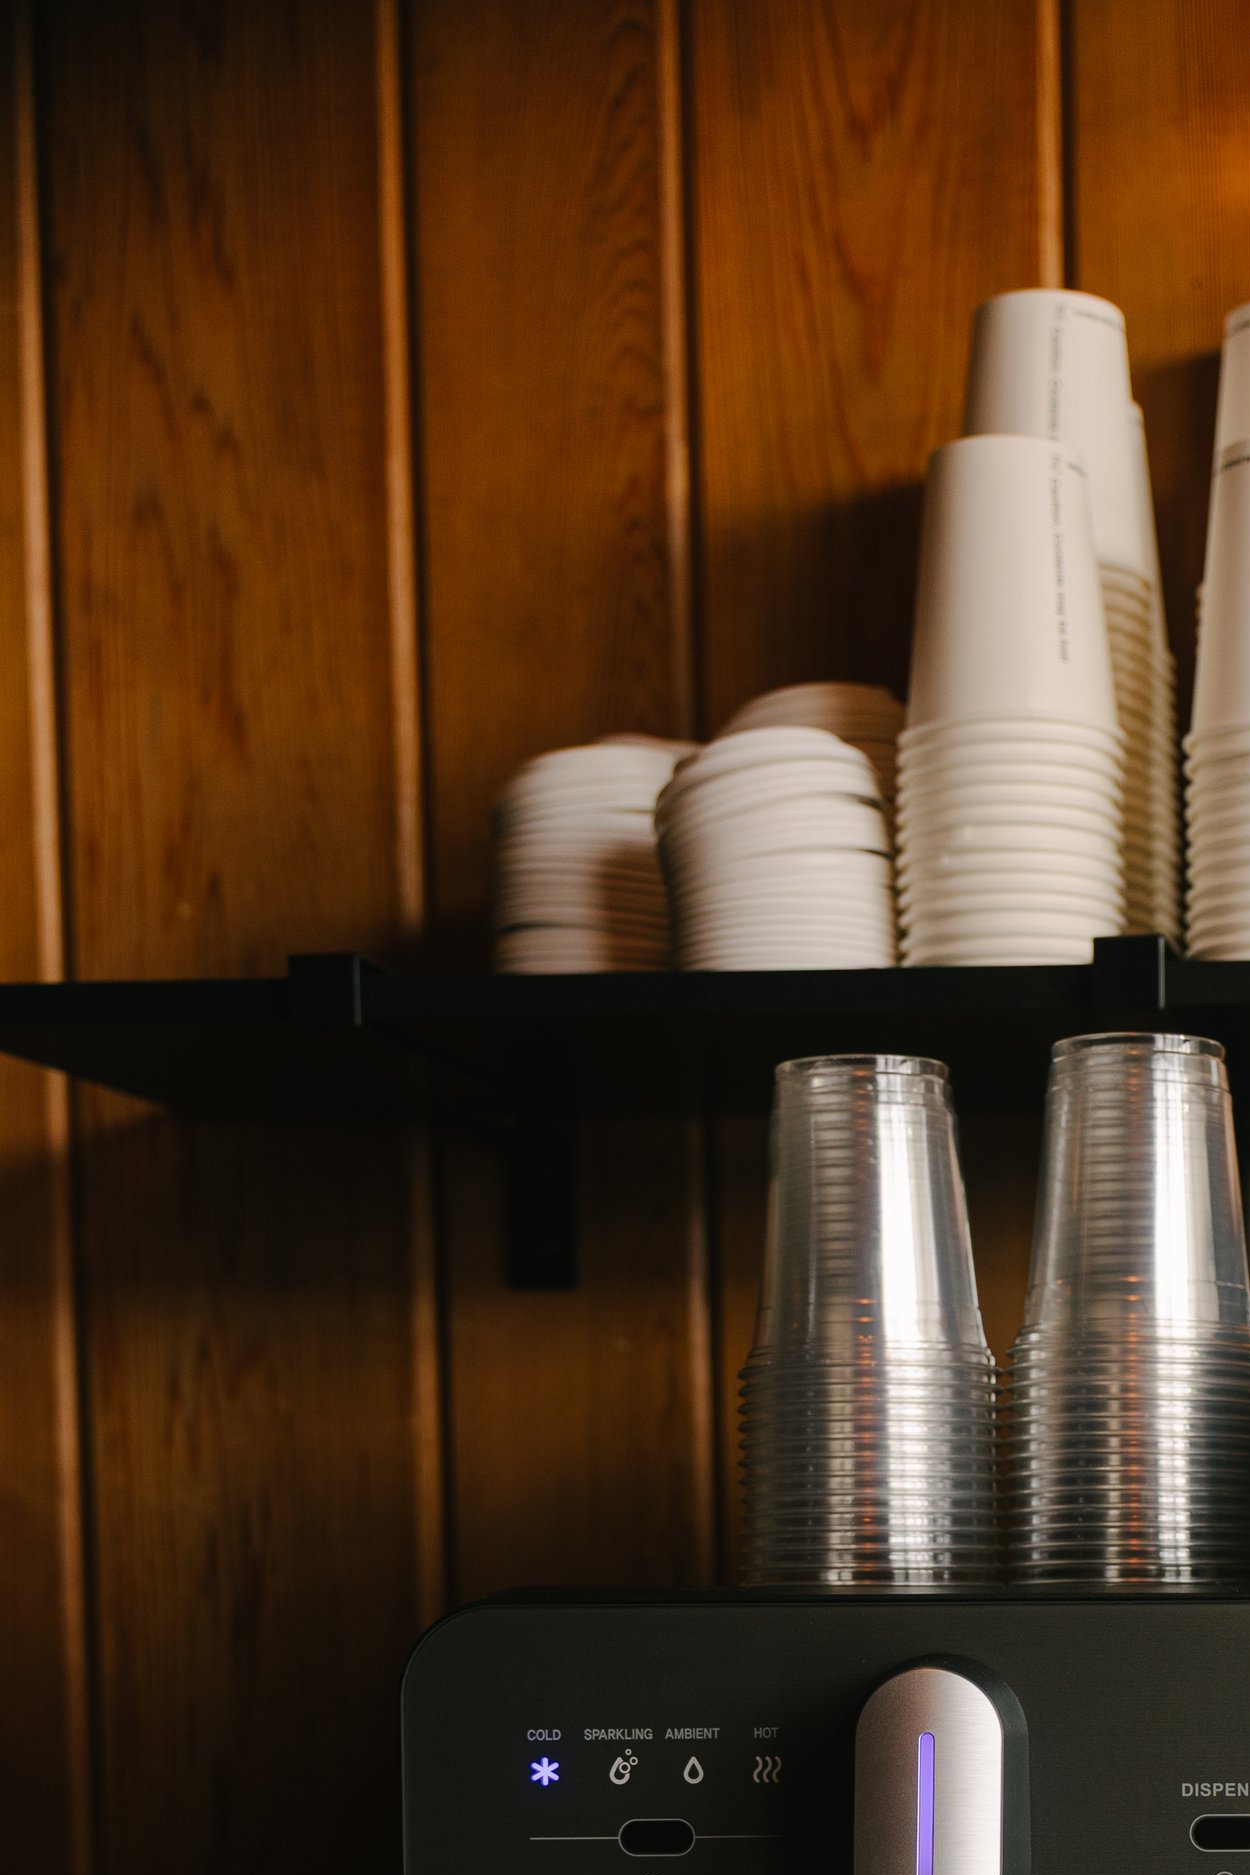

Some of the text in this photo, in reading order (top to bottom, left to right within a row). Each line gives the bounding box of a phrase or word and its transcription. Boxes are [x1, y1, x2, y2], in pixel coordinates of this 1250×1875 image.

[527, 1729, 561, 1741] COLD
[584, 1728, 653, 1740] SPARKLING
[665, 1728, 720, 1740] AMBIENT
[754, 1727, 779, 1739] HOT
